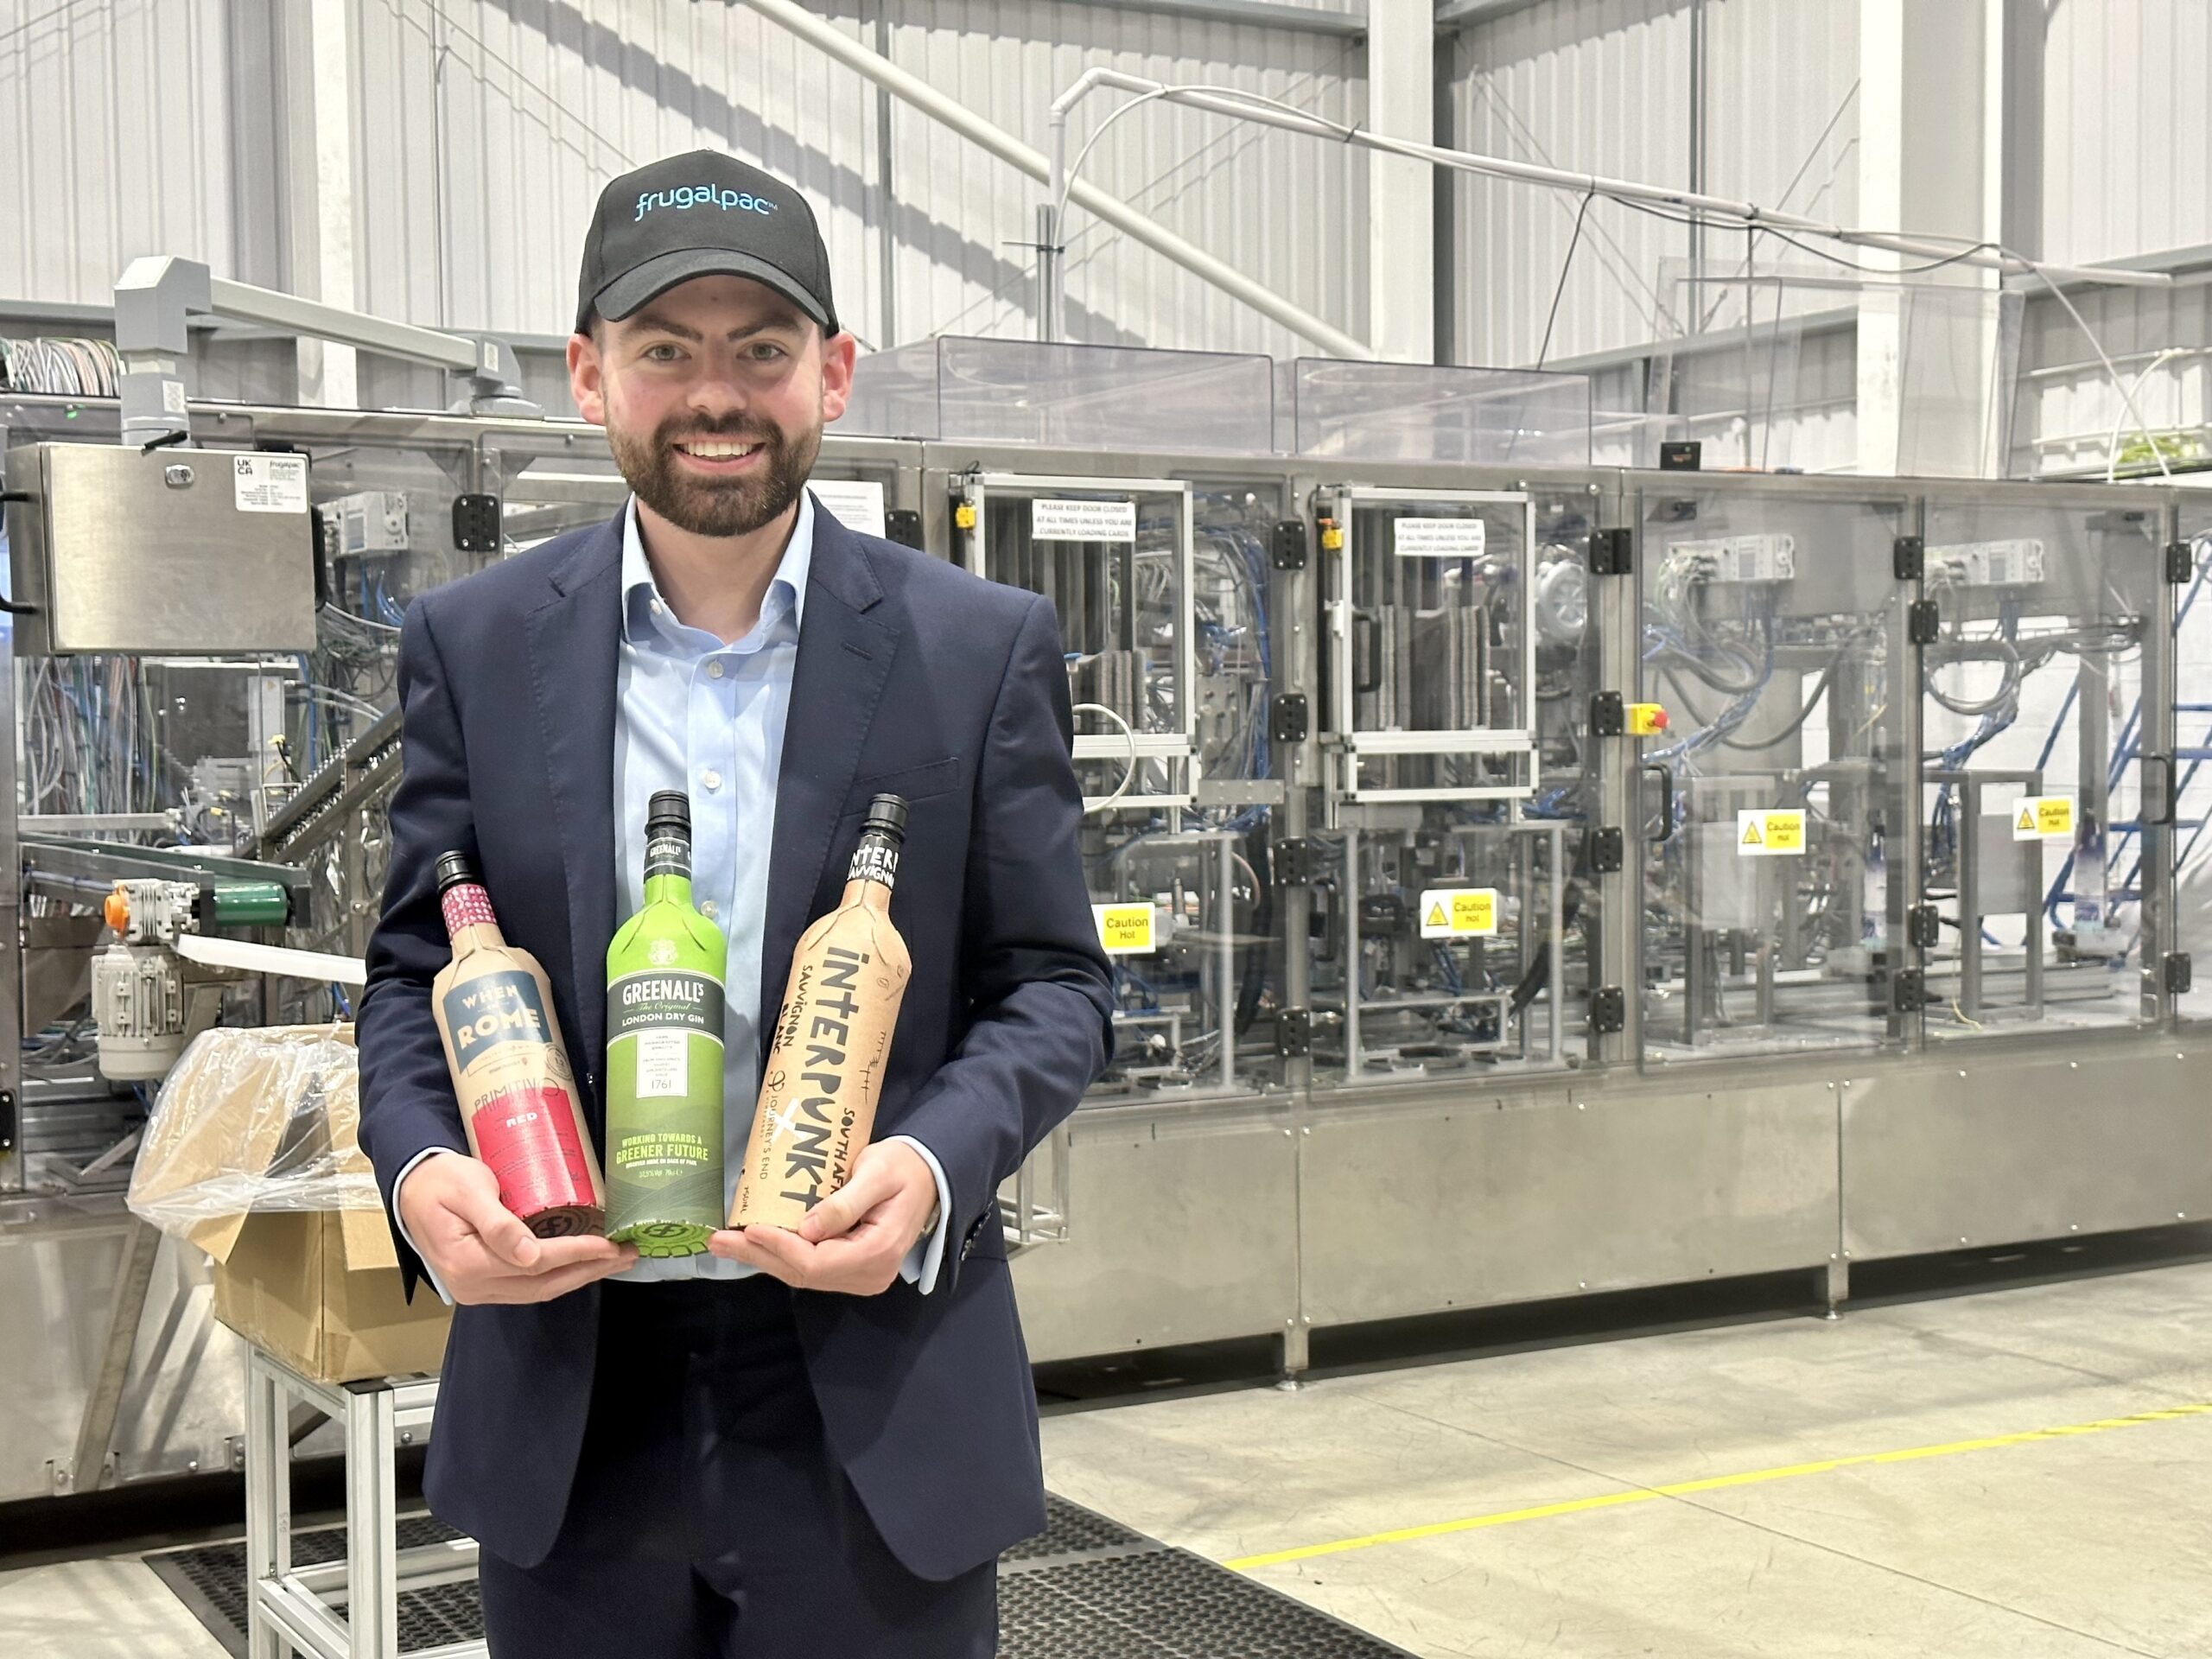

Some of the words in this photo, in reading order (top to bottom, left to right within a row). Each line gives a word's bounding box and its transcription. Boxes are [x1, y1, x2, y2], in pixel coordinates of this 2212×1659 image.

[1454, 902, 1491, 912] Caution
[1106, 917, 1148, 928] Caution
[1120, 931, 1135, 939] Hot
[462, 985, 519, 1009] WHEN
[623, 979, 704, 1005] GREENALL'S
[654, 1001, 691, 1012] Original
[457, 1007, 541, 1050] ROME
[622, 1013, 663, 1027] LONDON
[688, 1014, 704, 1024] GIN
[652, 1079, 671, 1090] 1761
[474, 1077, 560, 1121] PRIMITIVO
[505, 1112, 537, 1128] RED
[763, 1095, 778, 1154] JOURNEY'S
[622, 1134, 656, 1148] WORKING
[658, 1133, 696, 1144] TOWARDS
[696, 1135, 702, 1146] A
[834, 1108, 855, 1161] SOUTH
[616, 1144, 664, 1165] GREENER
[667, 1143, 709, 1161] FUTURE
[760, 1157, 770, 1179] END
